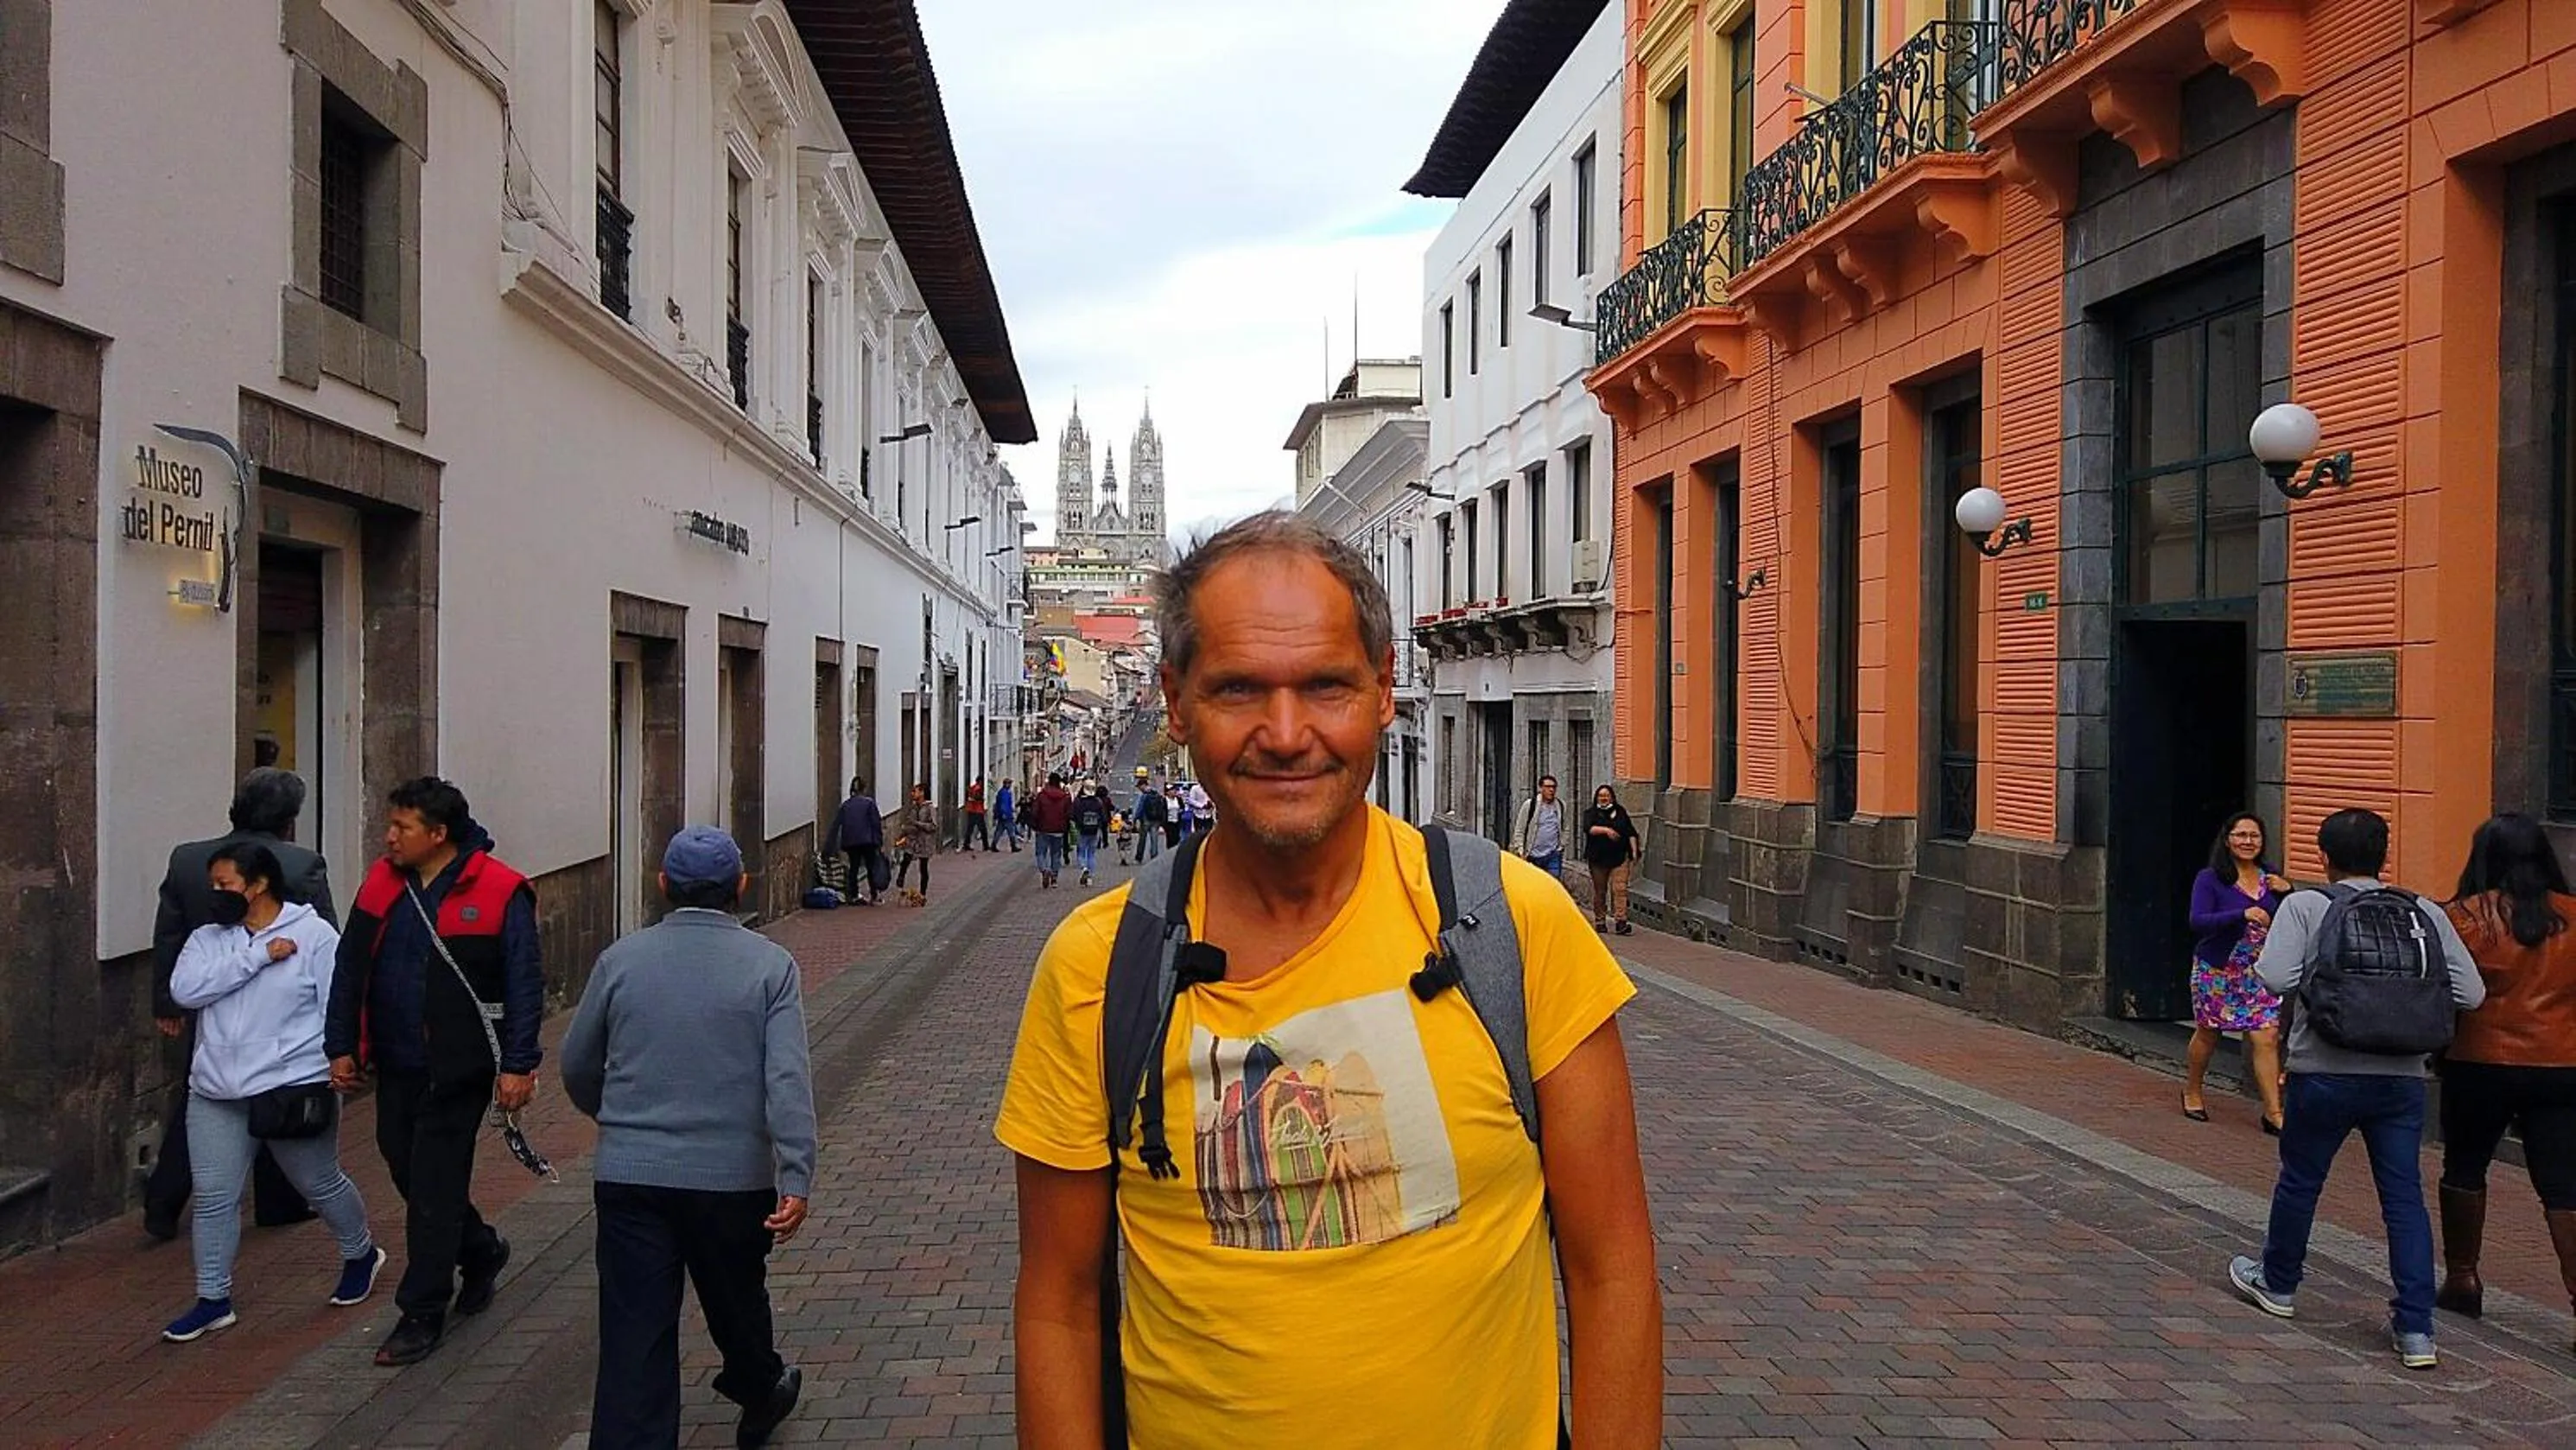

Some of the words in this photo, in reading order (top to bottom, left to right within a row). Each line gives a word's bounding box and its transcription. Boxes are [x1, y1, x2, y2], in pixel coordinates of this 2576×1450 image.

[136, 444, 203, 499] Museo
[121, 496, 154, 542] del
[161, 502, 214, 551] Pernil
